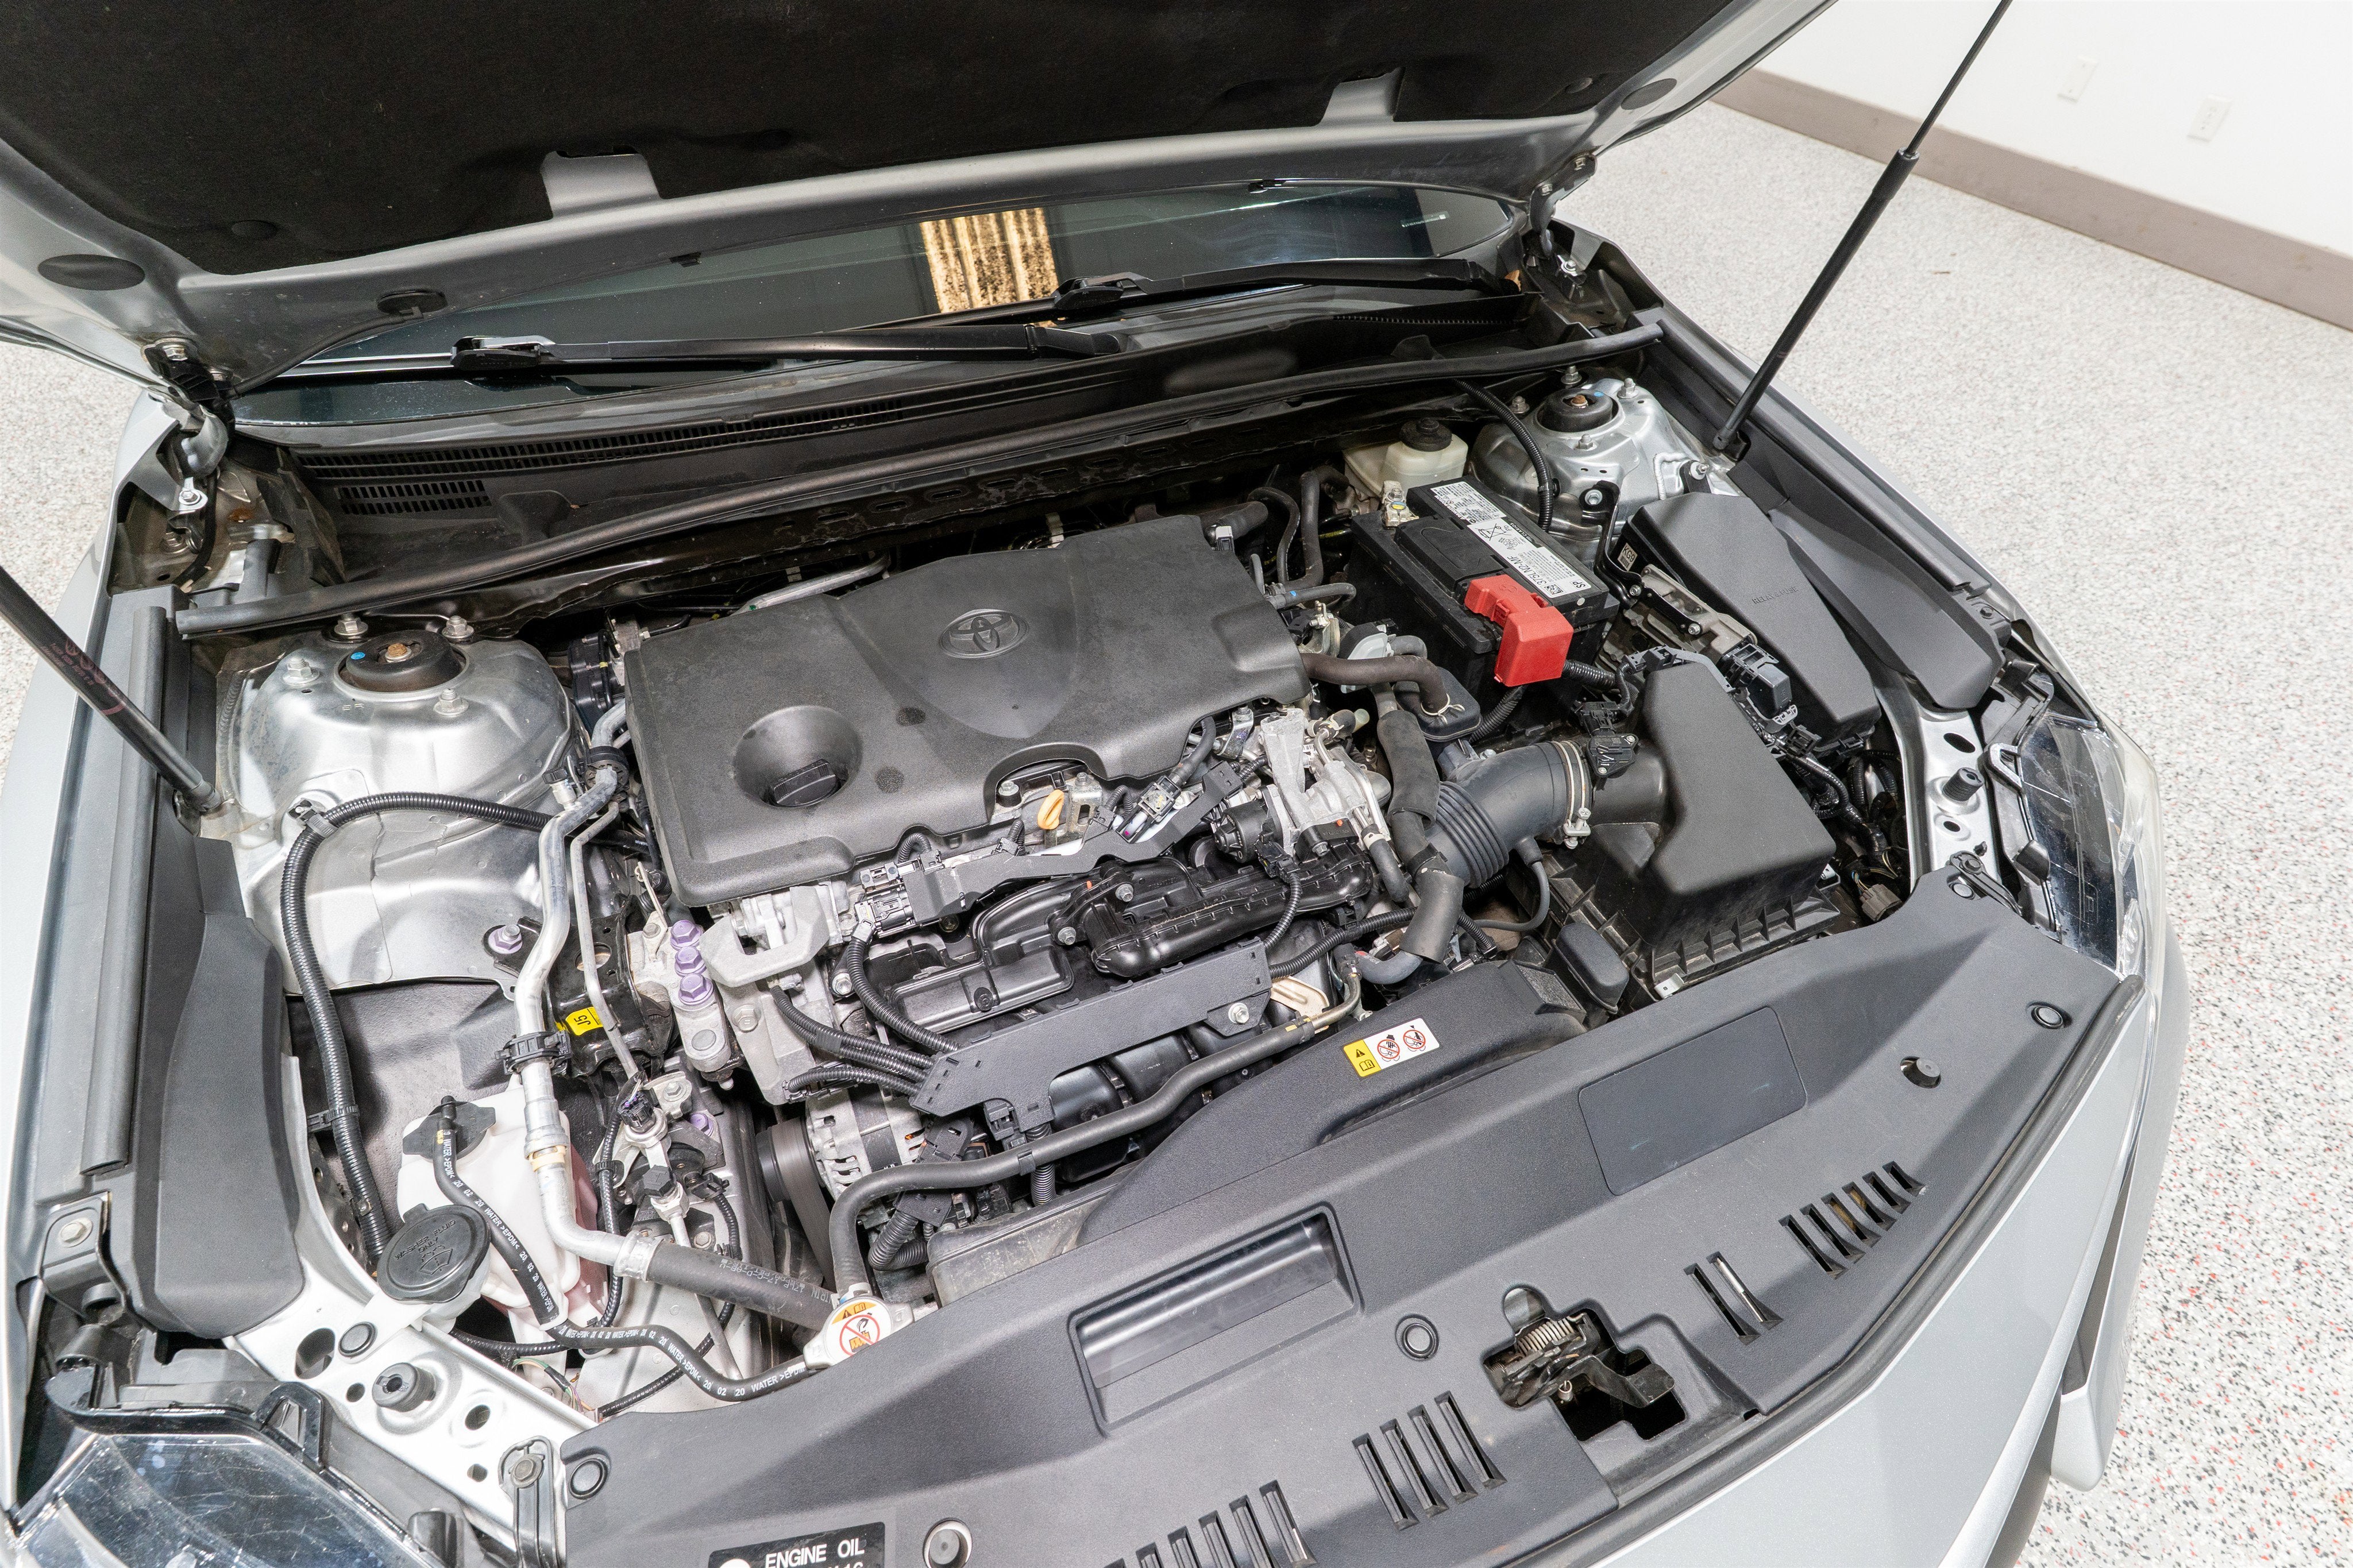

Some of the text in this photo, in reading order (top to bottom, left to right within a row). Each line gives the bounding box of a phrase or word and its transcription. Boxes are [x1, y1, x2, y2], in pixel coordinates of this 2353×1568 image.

[1509, 522, 1527, 536] CLARIOS
[1622, 546, 1635, 562] KG9
[1507, 556, 1546, 585] 375LN2-MF
[1752, 594, 1774, 604] RELAY
[1779, 586, 1799, 596] FUSE
[573, 1014, 591, 1025] J5
[443, 1138, 452, 1157] WATER
[464, 1189, 473, 1197] 02
[484, 1207, 503, 1227] WATER
[527, 1262, 534, 1272] 02
[537, 1280, 548, 1299] WATER
[395, 1219, 457, 1260] WASHER FLUID
[418, 1237, 439, 1254] ONLY
[649, 1330, 656, 1339] 02
[668, 1342, 684, 1363] WATER
[717, 1387, 727, 1396] 02
[735, 1387, 745, 1397] 20
[751, 1376, 778, 1392] WATER
[765, 1538, 865, 1568] ENGINE OIL
